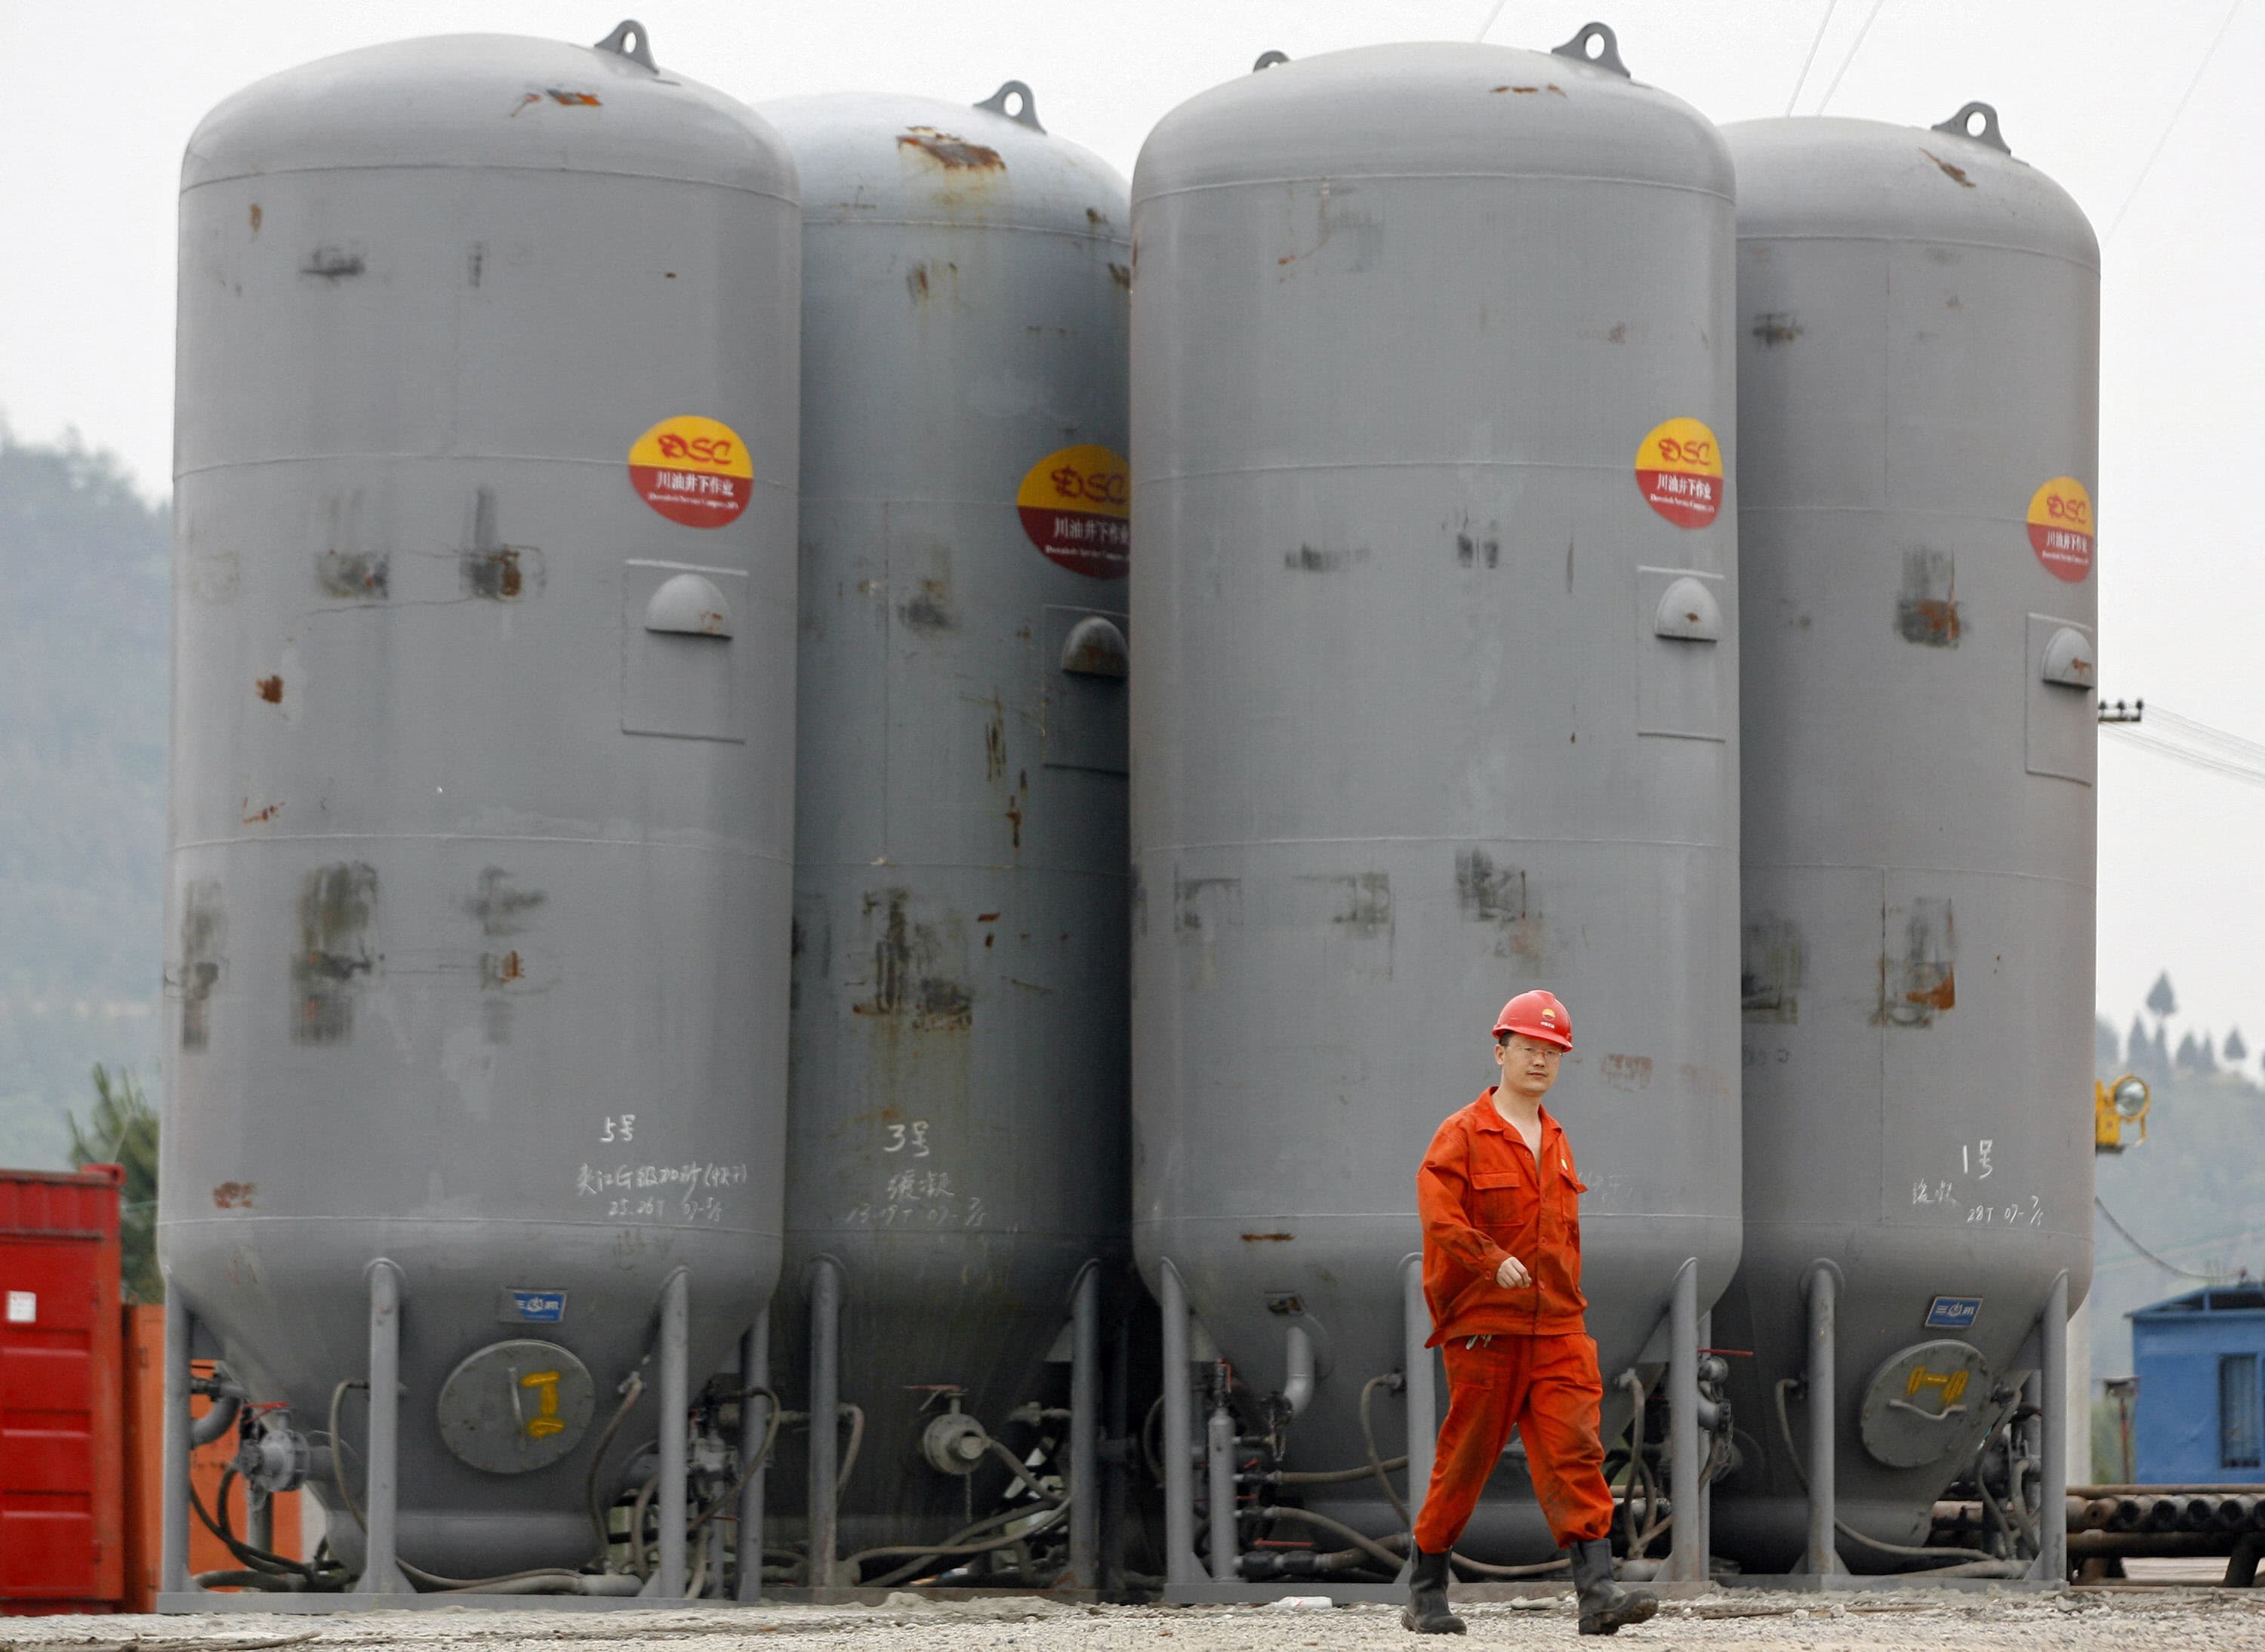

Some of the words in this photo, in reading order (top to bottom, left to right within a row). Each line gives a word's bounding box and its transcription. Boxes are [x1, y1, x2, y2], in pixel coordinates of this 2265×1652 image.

[656, 470, 735, 498] 川油井下作业
[1656, 473, 1712, 501] 川油井下作业
[883, 1120, 930, 1157] 3号
[1962, 1139, 1994, 1179] 1号
